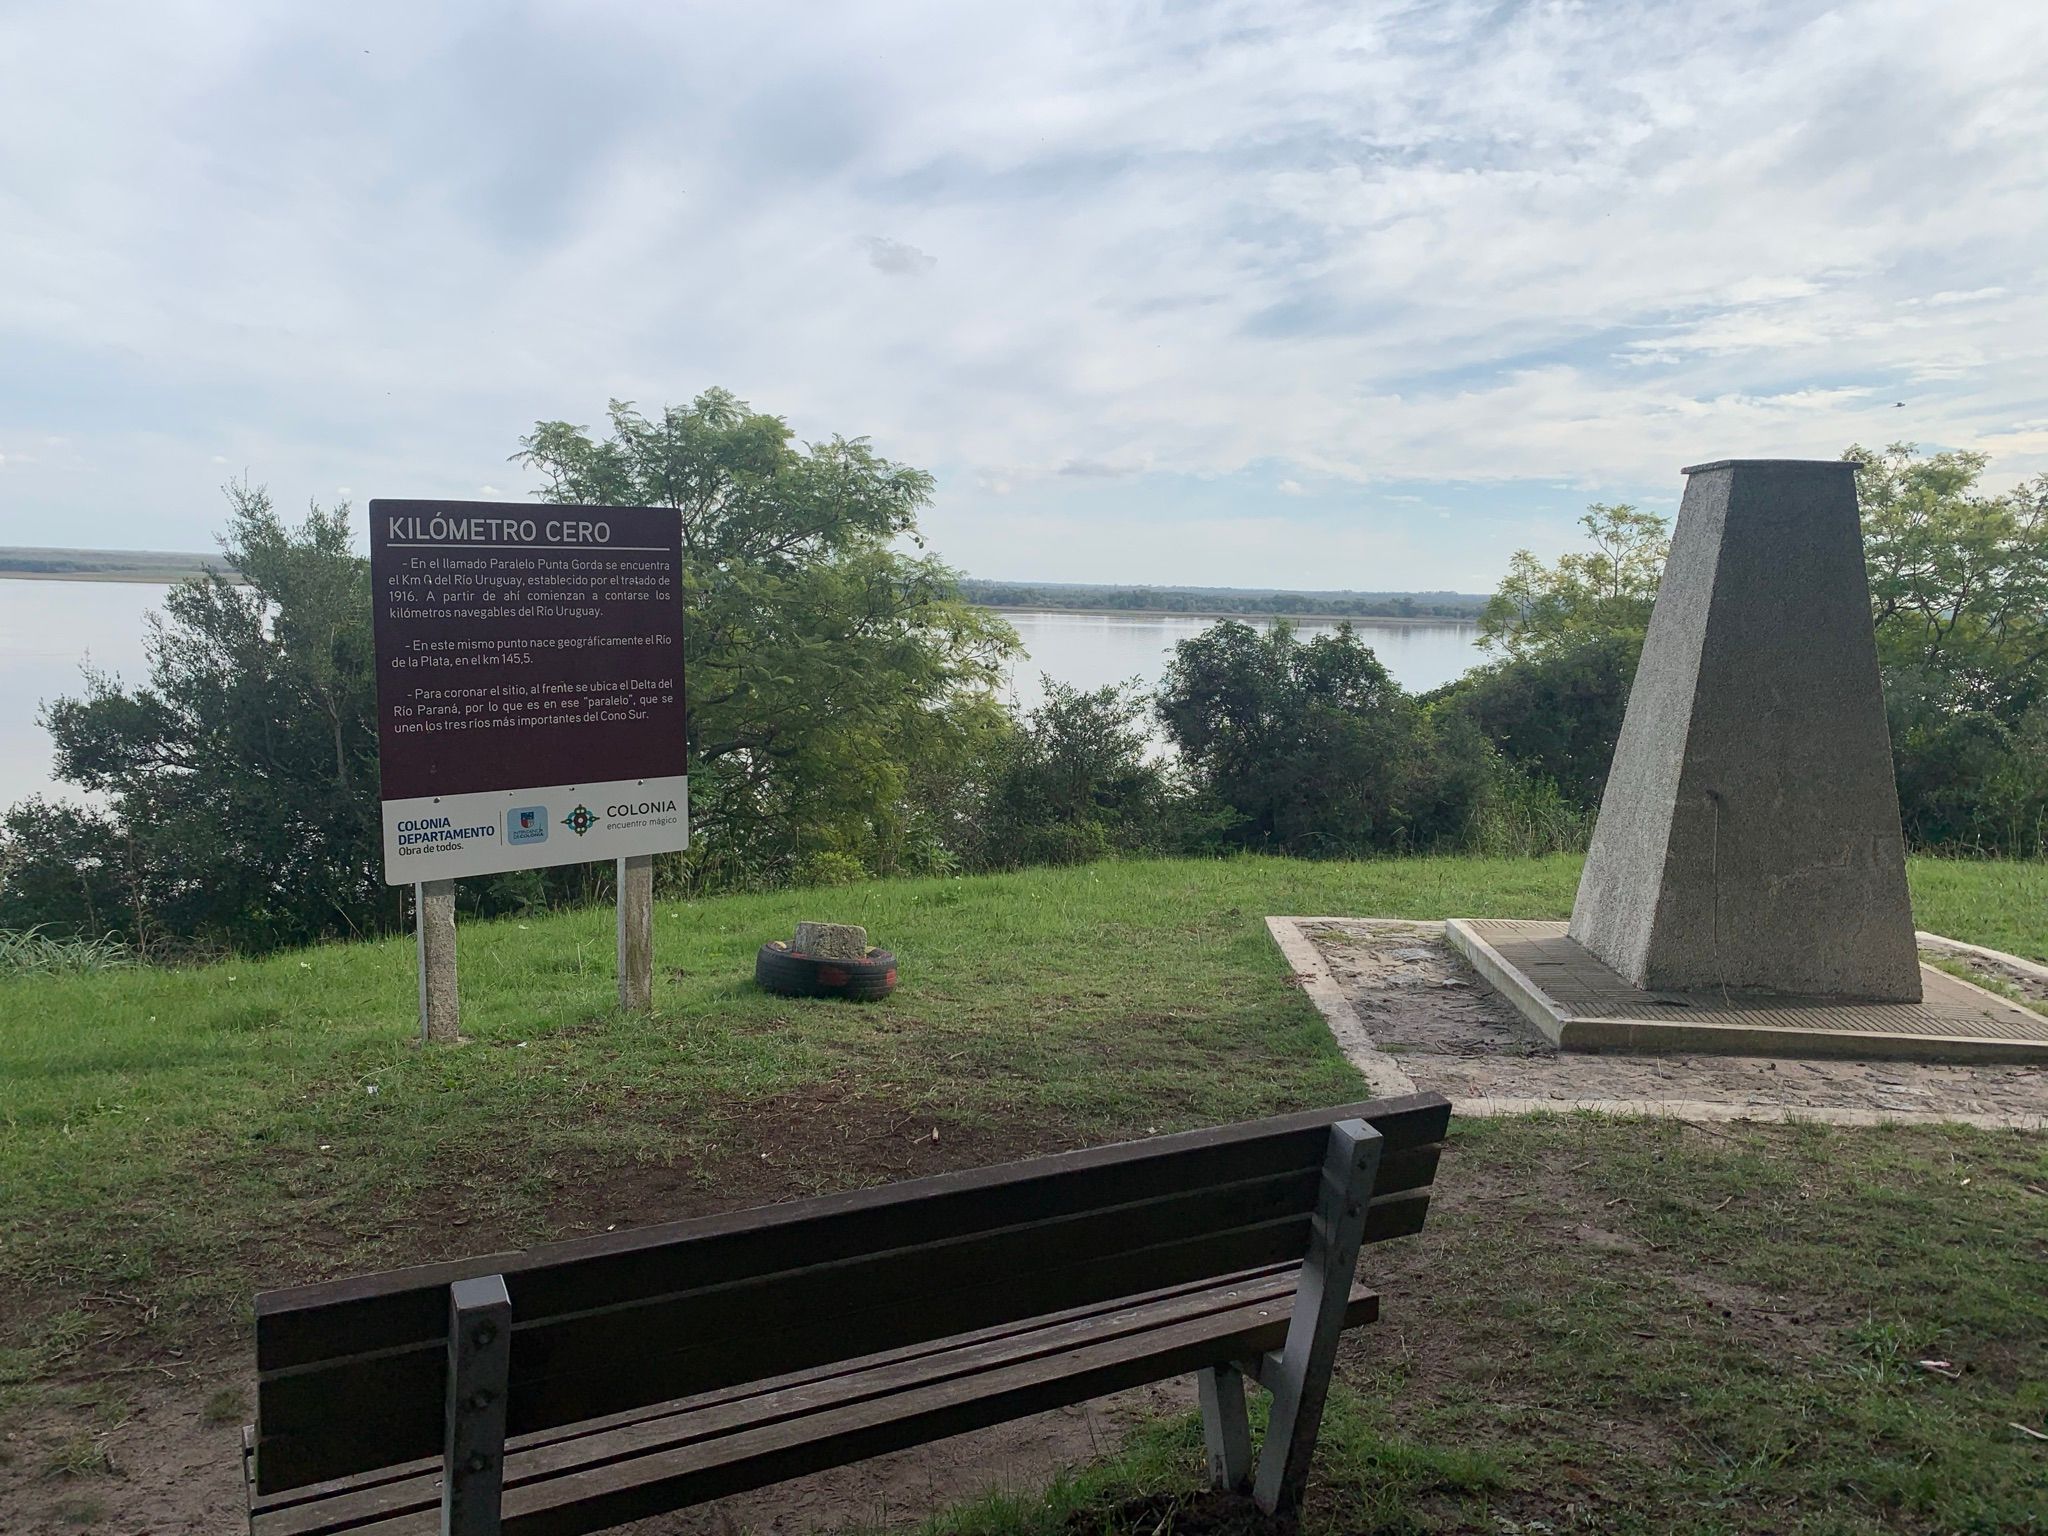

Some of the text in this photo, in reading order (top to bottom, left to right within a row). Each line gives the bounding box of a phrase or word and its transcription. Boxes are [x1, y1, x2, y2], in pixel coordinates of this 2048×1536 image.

[389, 511, 611, 543] KILÓMETRO CERO
[410, 557, 426, 569] En
[429, 558, 440, 569] el
[443, 558, 487, 569] llamado
[490, 558, 535, 570] Paralelo
[537, 559, 569, 570] Punta
[571, 559, 603, 570] Gorda
[605, 562, 618, 570] se
[620, 561, 670, 571] encuentra
[388, 574, 399, 585] el
[402, 574, 420, 585] Km
[434, 574, 451, 585] del
[454, 574, 473, 585] Río
[475, 574, 525, 588] Uruguay,
[527, 574, 588, 585] establecido
[590, 577, 608, 588] por
[610, 575, 619, 586] el
[621, 575, 656, 586] tratado
[658, 576, 671, 586] de
[389, 590, 671, 605] 1916. A partir de ahí comienzan a contarse los
[389, 605, 604, 620] kilómetros navegables del Río Uruguay.
[413, 639, 428, 651] En
[430, 640, 455, 651] este
[457, 638, 495, 651] mismo
[497, 639, 528, 652] punto
[530, 639, 555, 648] nace
[557, 636, 643, 649] geográficamente
[645, 634, 655, 646] el
[656, 634, 672, 646] Río
[391, 652, 534, 668] de la Plata, en el km 145,5.
[415, 688, 442, 700] Para
[444, 688, 488, 699] coronar
[490, 685, 500, 697] el
[502, 684, 528, 697] sitio,
[530, 683, 540, 695] al
[542, 682, 574, 694] frente
[575, 683, 588, 692] se
[590, 680, 618, 692] ubica
[619, 680, 629, 691] el
[630, 679, 657, 690] Delta
[658, 678, 673, 689] del
[393, 705, 413, 717] Río
[417, 702, 461, 716] Paraná,
[465, 703, 484, 716] por
[488, 701, 499, 712] lo
[502, 702, 523, 714] que
[527, 701, 540, 710] es
[543, 699, 557, 709] en
[561, 699, 580, 708] ese
[639, 695, 658, 707] que
[661, 695, 673, 704] se
[394, 709, 650, 733] unen los tres ríos más importantes del Cono Sur.
[607, 800, 677, 818] COLONIA
[397, 817, 451, 832] COLONIA
[607, 816, 677, 830] encuentro mágico
[398, 825, 495, 845] DEPARTAMENTO
[398, 841, 464, 856] Obra de todos.
